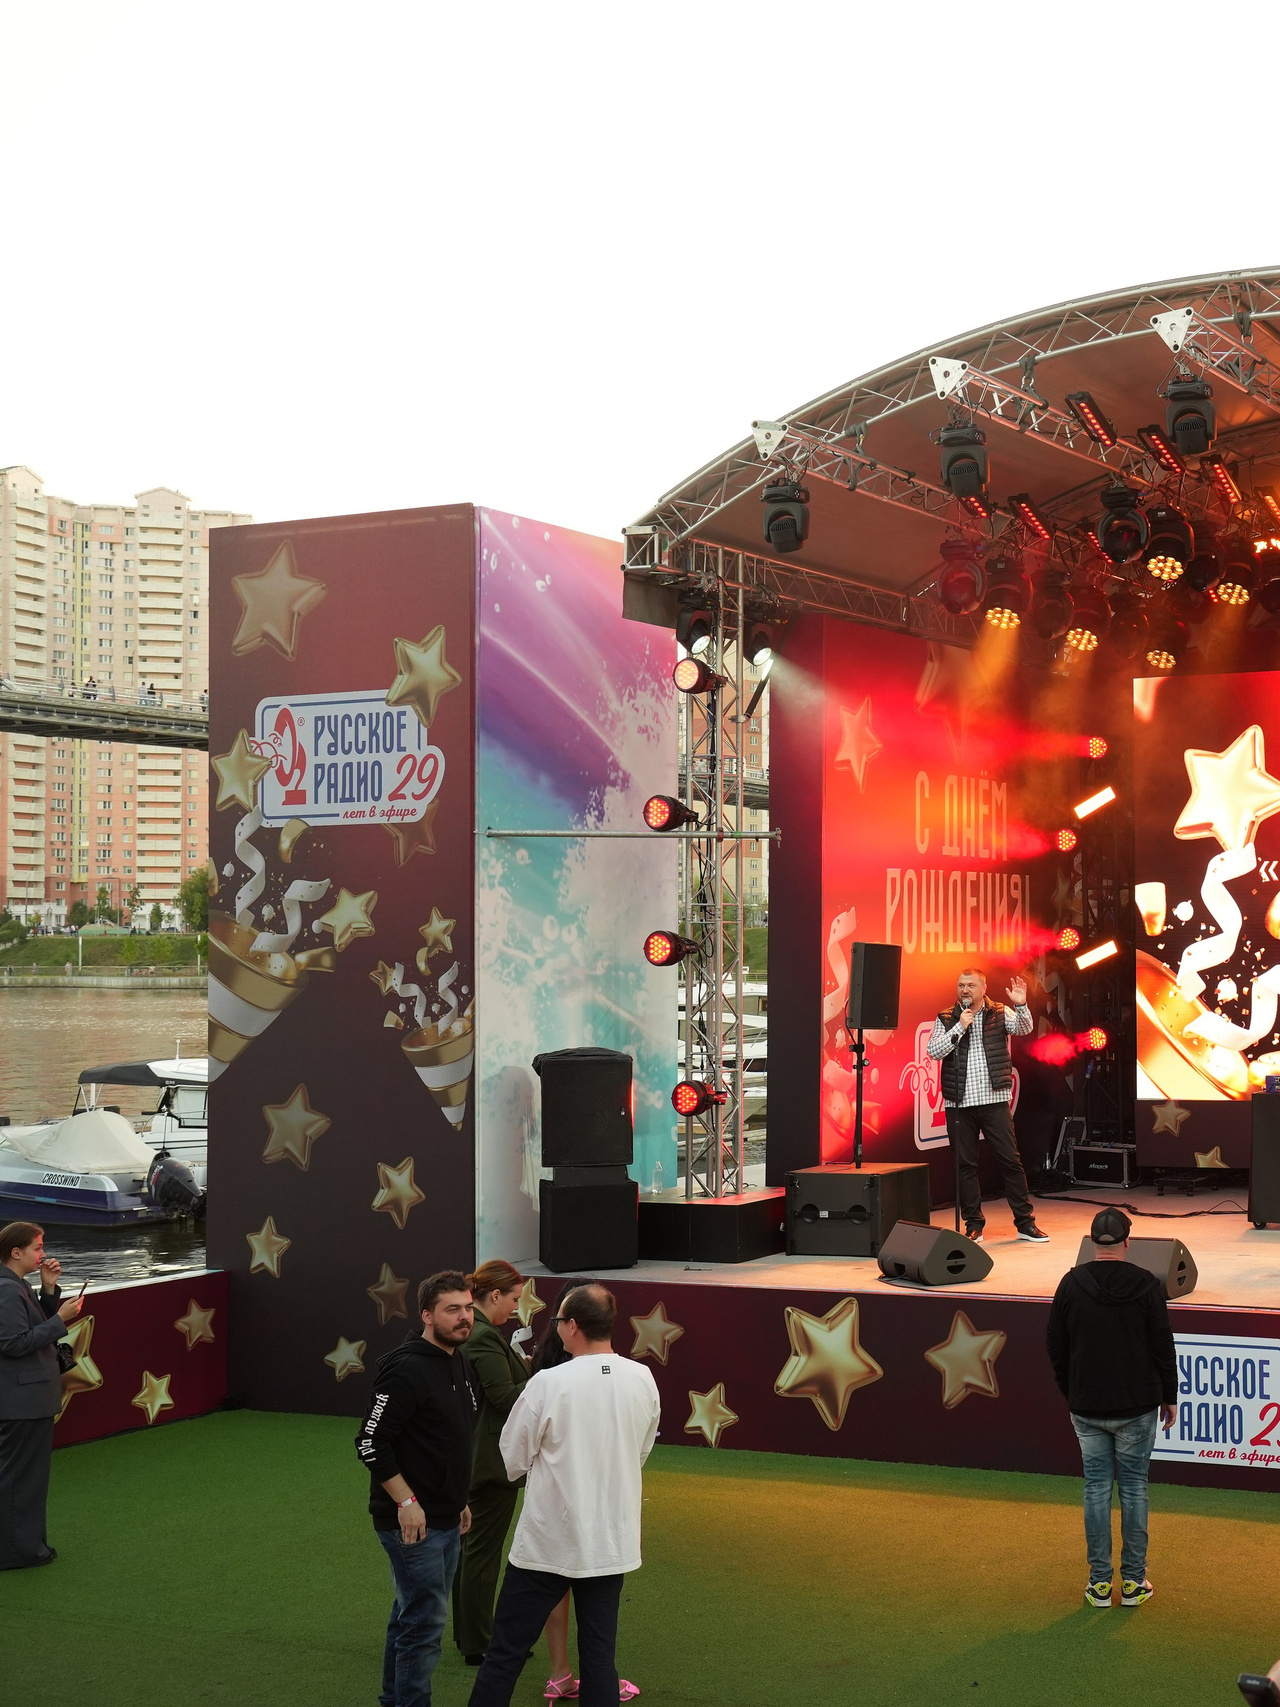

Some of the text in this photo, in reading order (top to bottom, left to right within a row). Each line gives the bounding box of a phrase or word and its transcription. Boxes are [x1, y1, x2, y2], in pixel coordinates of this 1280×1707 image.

[313, 710, 407, 757] РУССКОЕ
[313, 753, 439, 804] РАДИО 29
[342, 805, 418, 822] лет в эфире
[915, 770, 1007, 862] С ДНЁМ
[42, 1173, 80, 1187] CROSSWIND
[1178, 1355, 1271, 1400] УССКОЕ
[1198, 1448, 1226, 1459] лет
[1228, 1447, 1238, 1460] в
